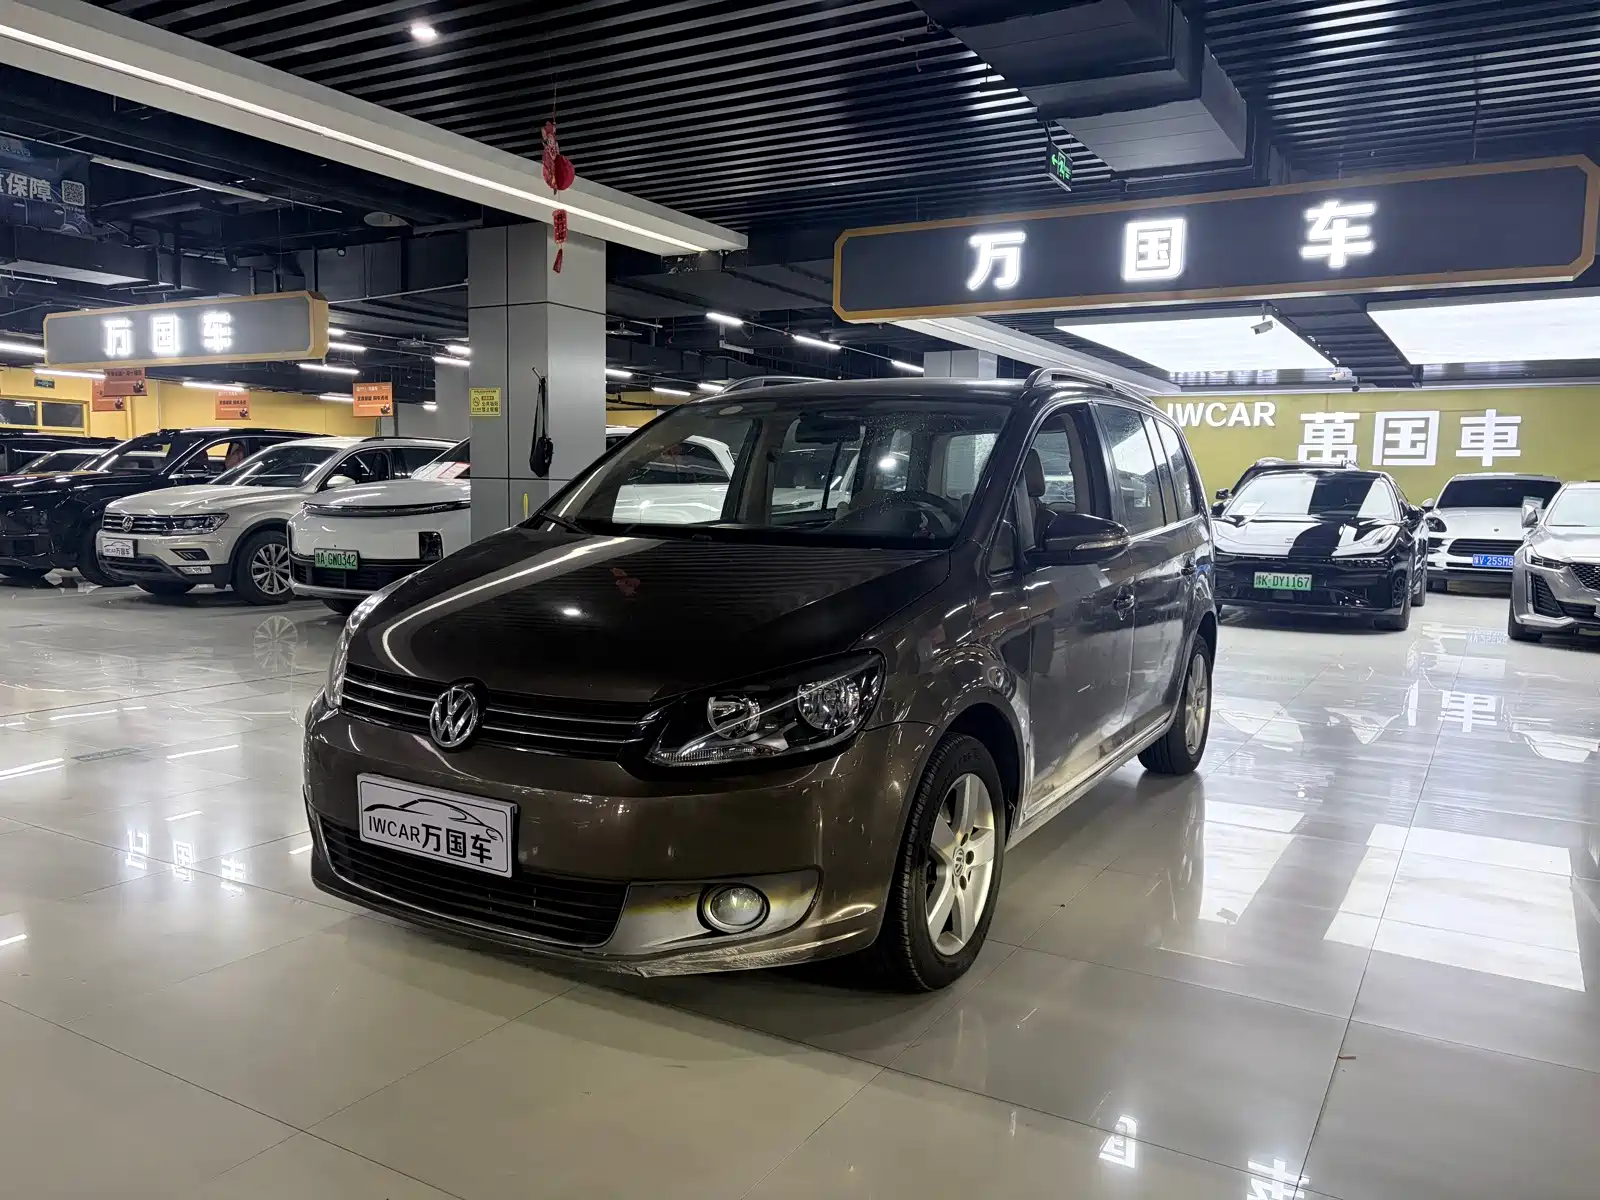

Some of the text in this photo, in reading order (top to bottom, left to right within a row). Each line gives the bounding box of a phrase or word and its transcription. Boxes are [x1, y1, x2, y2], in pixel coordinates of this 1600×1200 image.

[0, 172, 52, 202] 保障
[967, 200, 1375, 291] 万国车
[102, 310, 232, 358] 万国车
